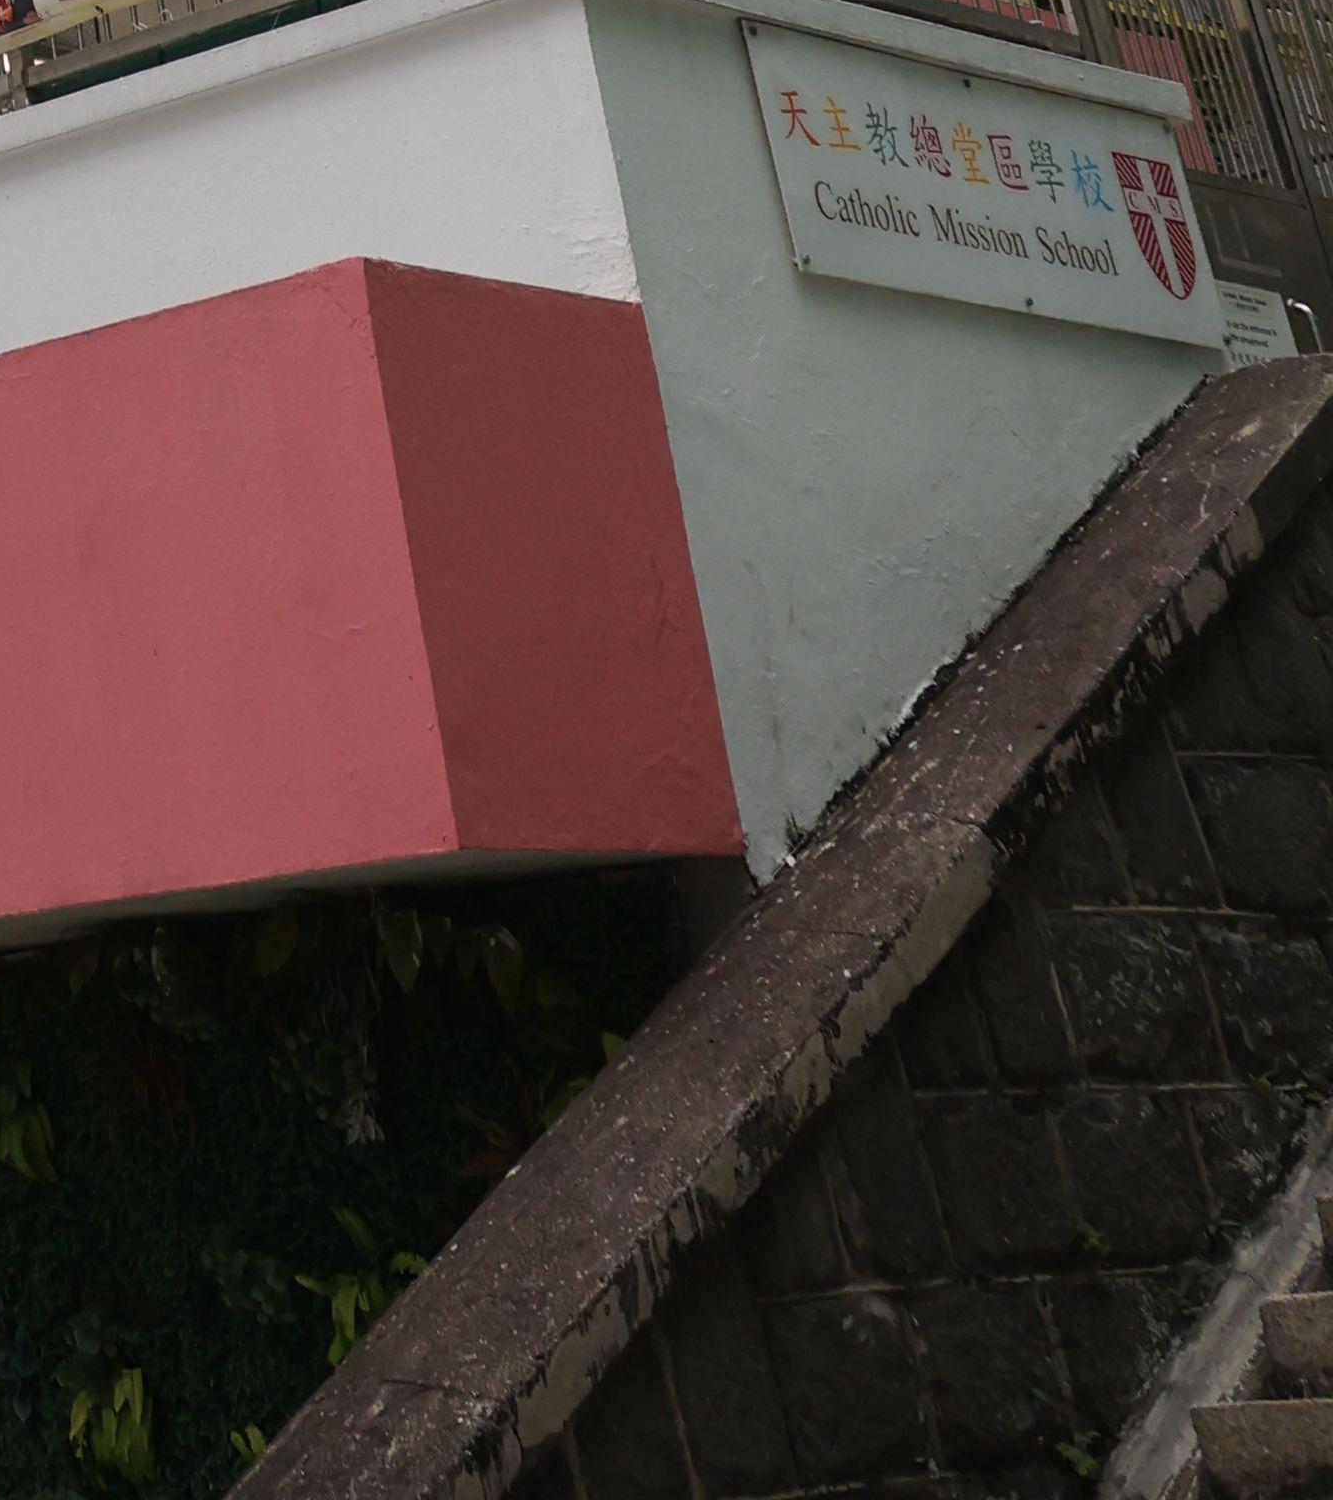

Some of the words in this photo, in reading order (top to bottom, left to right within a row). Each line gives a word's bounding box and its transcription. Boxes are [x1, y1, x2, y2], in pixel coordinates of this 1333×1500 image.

[779, 90, 1116, 213] 天主教總堂區學校
[814, 180, 921, 238] Catholic
[927, 203, 1030, 261] Mission
[1035, 226, 1120, 277] School
